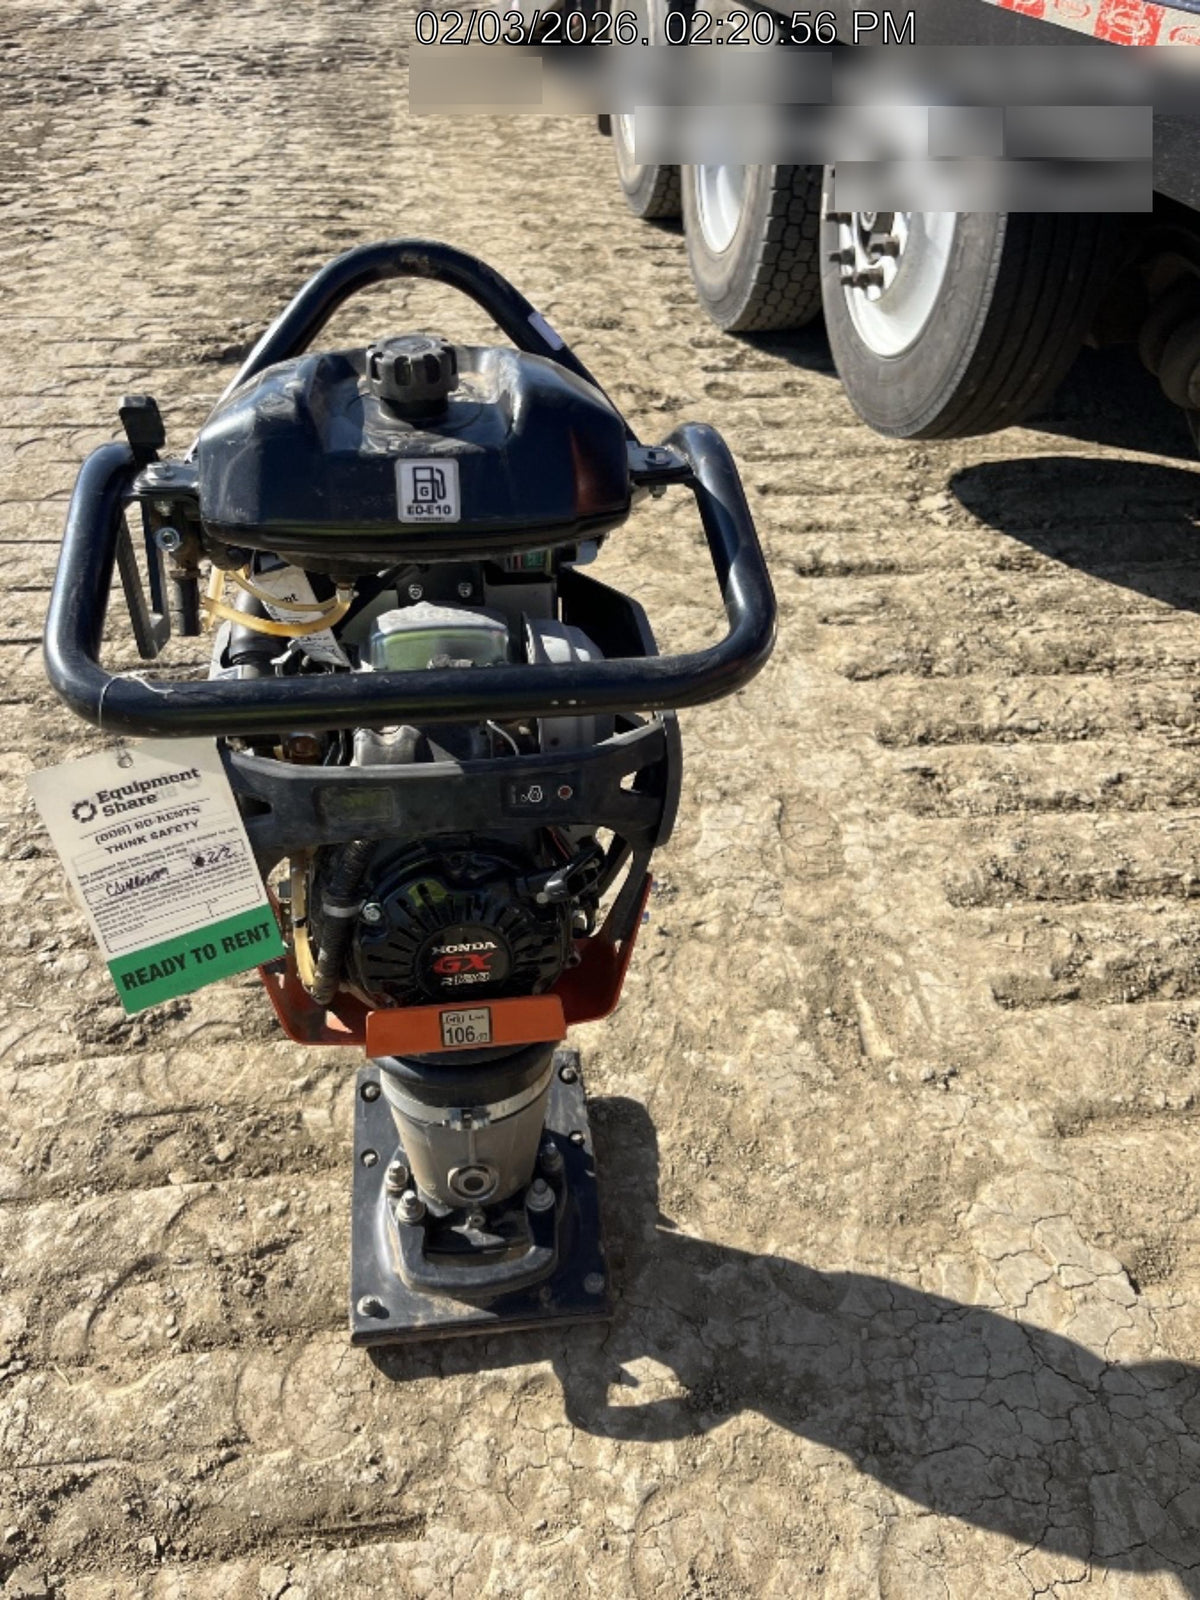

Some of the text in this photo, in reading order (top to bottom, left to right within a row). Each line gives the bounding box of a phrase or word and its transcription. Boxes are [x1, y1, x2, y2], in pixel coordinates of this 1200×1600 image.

[95, 767, 201, 804] Equipment
[102, 793, 158, 817] Share
[104, 820, 199, 855] THINK SAFETY
[120, 922, 270, 991] READY TO RENT
[432, 941, 498, 956] HONDA
[432, 951, 494, 975] GX
[446, 1024, 475, 1044] 106
